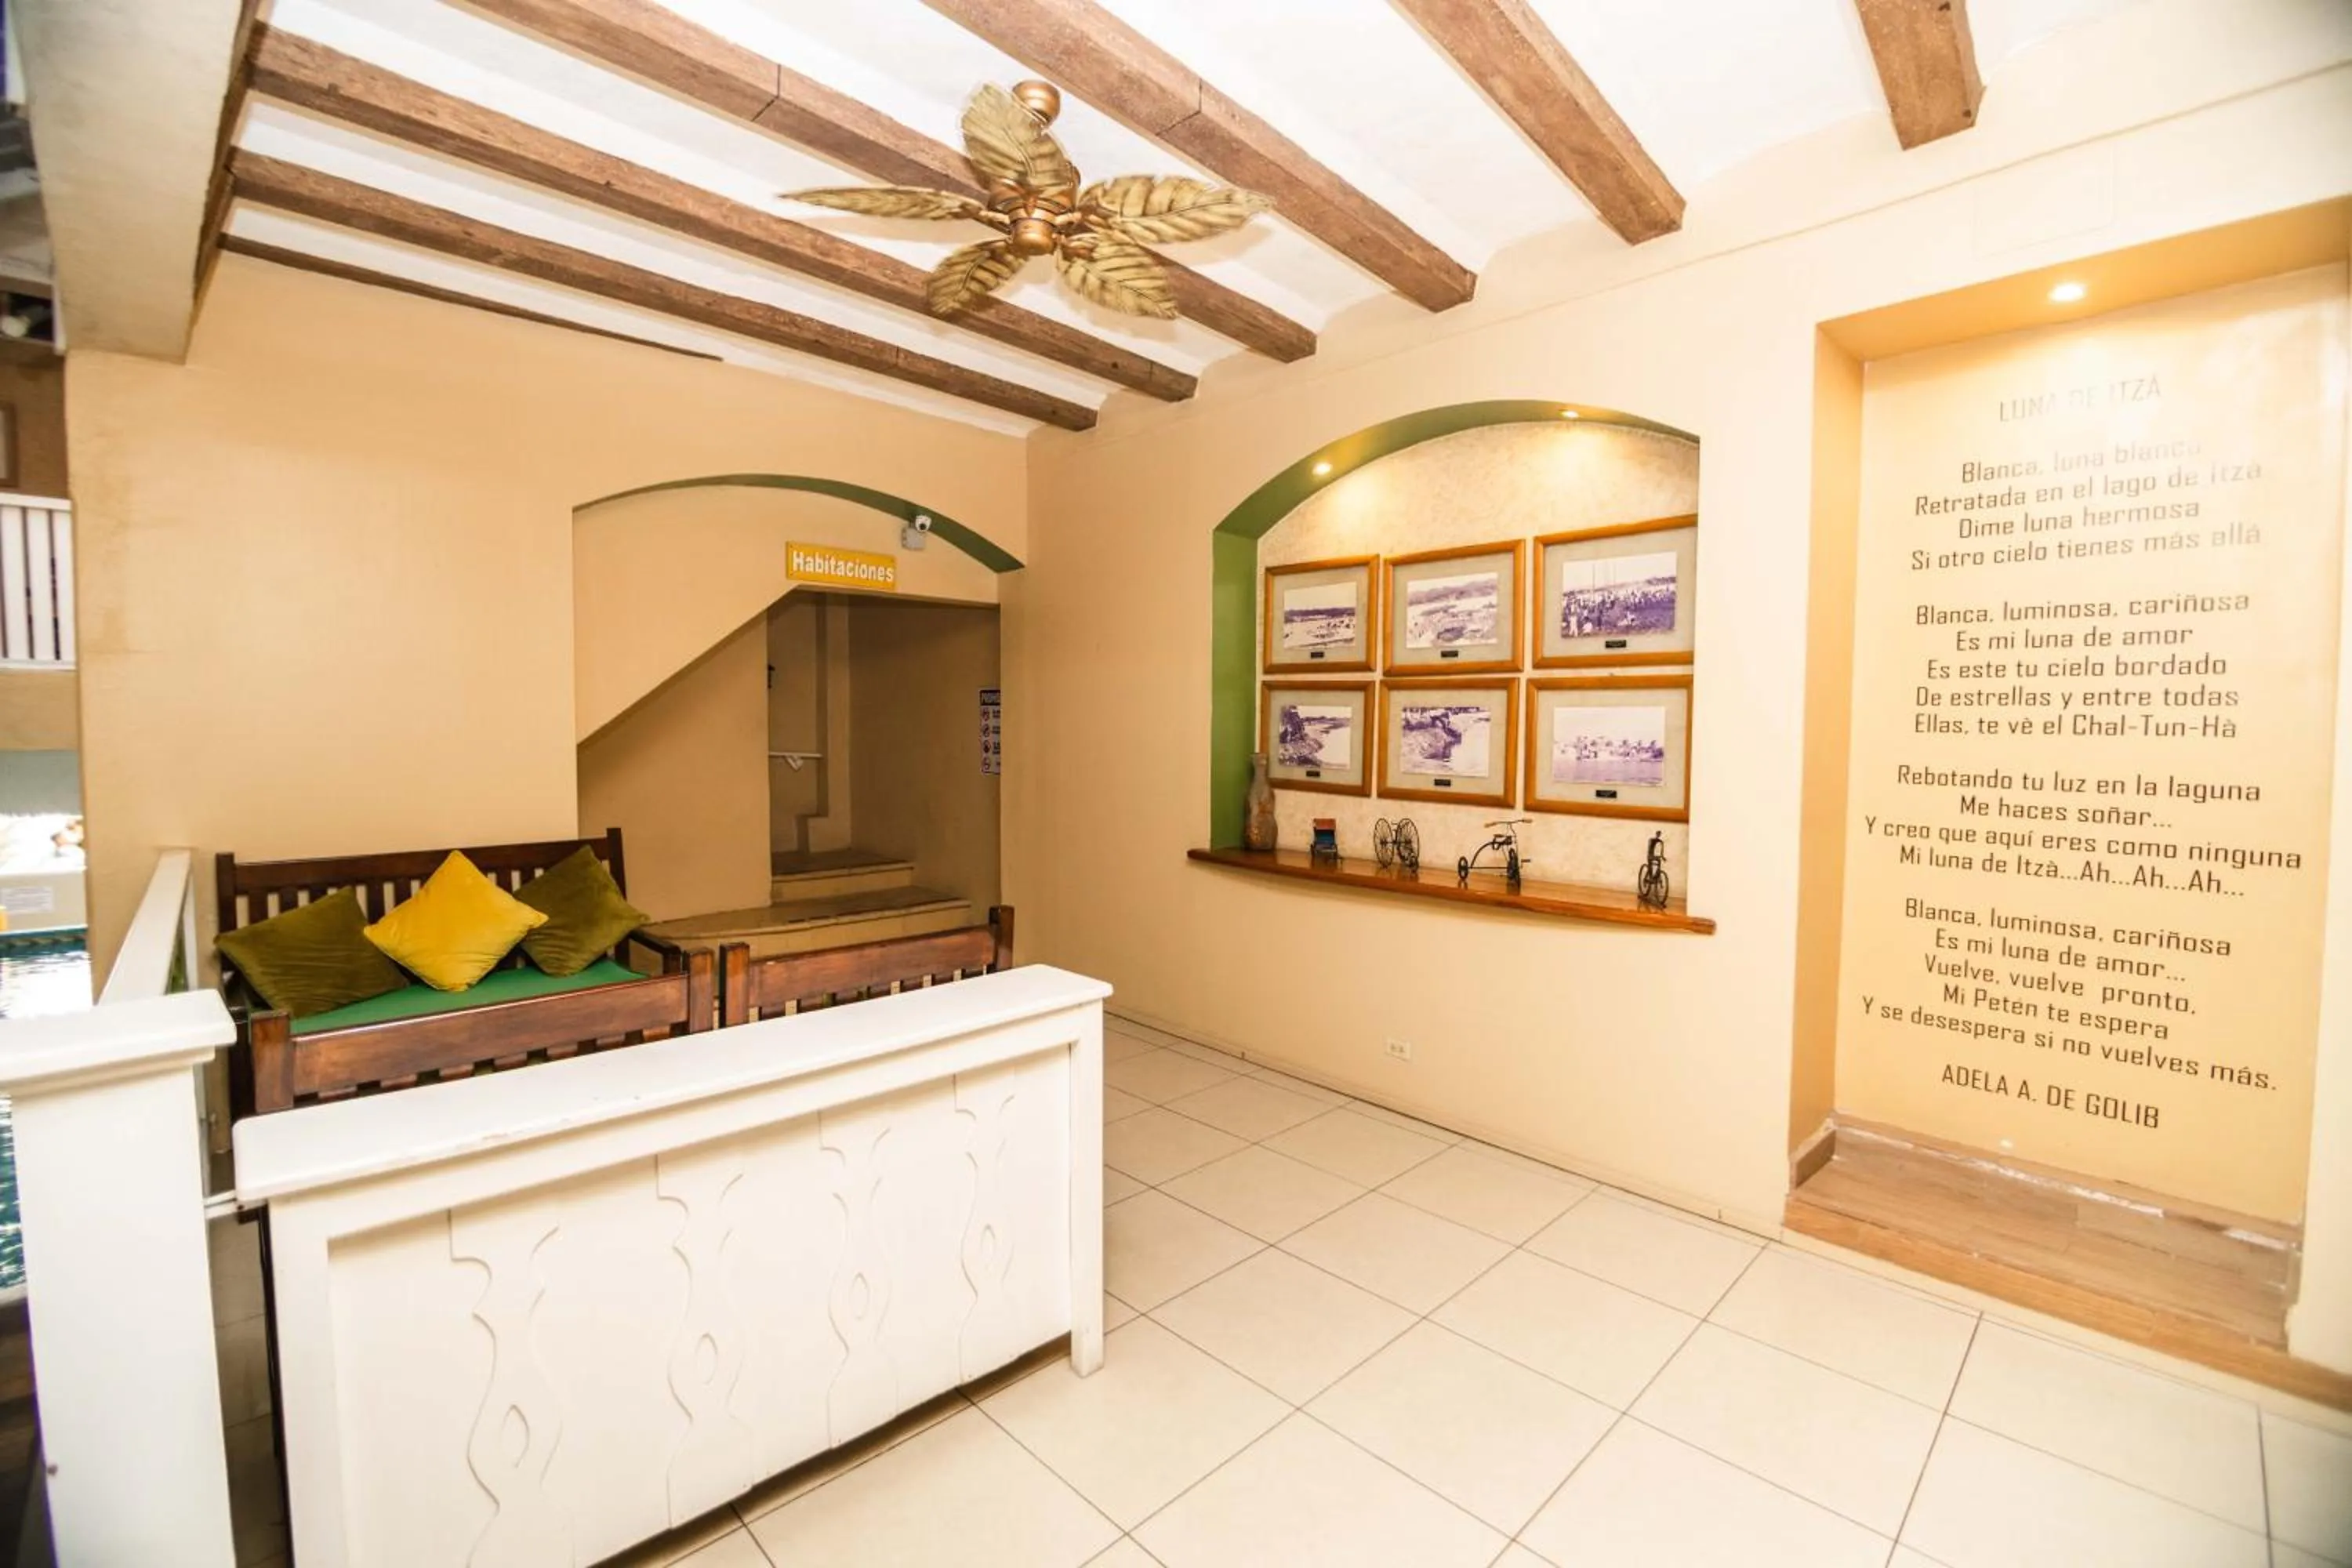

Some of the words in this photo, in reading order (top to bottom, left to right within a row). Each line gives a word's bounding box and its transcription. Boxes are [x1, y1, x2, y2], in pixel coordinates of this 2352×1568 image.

[2053, 450, 2104, 472] luna
[1915, 486, 2026, 516] Retratada
[2036, 486, 2063, 503] en
[2073, 476, 2093, 499] el
[2103, 474, 2157, 498] lago
[2168, 466, 2198, 488] de
[1959, 518, 2014, 539] Dime
[2024, 512, 2073, 532] luna
[2082, 502, 2200, 527] hermosa
[793, 550, 894, 582] Habitaciones
[1911, 550, 1930, 571] Si
[1938, 551, 1984, 568] otro
[1994, 540, 2047, 564] cielo
[2057, 539, 2133, 559] tienes
[2129, 593, 2250, 615] cariñosa
[1956, 630, 1980, 652] Es
[1988, 634, 2015, 650] mi
[2024, 628, 2074, 648] luna
[2083, 626, 2112, 647] de
[2122, 629, 2194, 646] amor
[1927, 659, 1951, 679] Es
[1958, 661, 2006, 678] este
[2016, 661, 2038, 678] tu
[2047, 655, 2104, 677] cielo
[2114, 652, 2227, 677] bordado
[1916, 686, 1942, 706] De
[1950, 685, 2051, 706] estrellas
[2061, 691, 2073, 710] y
[2082, 688, 2151, 706] entre
[2164, 684, 2238, 706] todas
[1978, 717, 1999, 735] te
[2042, 714, 2063, 735] el
[1897, 764, 2013, 789] Rebotando
[2022, 773, 2044, 791] tu
[2053, 770, 2086, 793] luz
[2096, 779, 2125, 795] en
[2136, 773, 2158, 797] la
[2169, 775, 2260, 804] laguna
[1960, 795, 1989, 816] Me
[1998, 797, 2067, 821] haces
[2077, 807, 2172, 828] soñar...
[1865, 815, 1877, 835] Y
[1883, 823, 1931, 839] creo
[1938, 827, 1976, 845] que
[2042, 835, 2096, 852] eres
[2107, 840, 2177, 858] como
[2188, 841, 2301, 869] ninguna
[1900, 844, 1921, 865] Mi
[1929, 847, 1973, 870] luna
[1981, 852, 2007, 873] de
[1935, 927, 1958, 950] Es
[1967, 937, 1993, 954] mi
[2002, 937, 2049, 963] luna
[2059, 945, 2086, 967] de
[2096, 956, 2186, 982] amor...
[2113, 928, 2231, 956] cariñosa
[2009, 971, 2084, 996] vuelve
[1944, 983, 1965, 1005] Mi
[2047, 1003, 2070, 1023] te
[2079, 1012, 2169, 1040] espera
[1862, 995, 1874, 1015] Y
[1881, 1005, 1903, 1022] se
[1911, 1001, 2025, 1044] desespera
[2034, 1031, 2053, 1049] si
[2062, 1038, 2091, 1056] no
[2101, 1045, 2199, 1076] vuelves
[1941, 1064, 2009, 1096] ADELA
[2046, 1084, 2075, 1110] DE
[2085, 1093, 2159, 1129] GOLIB
